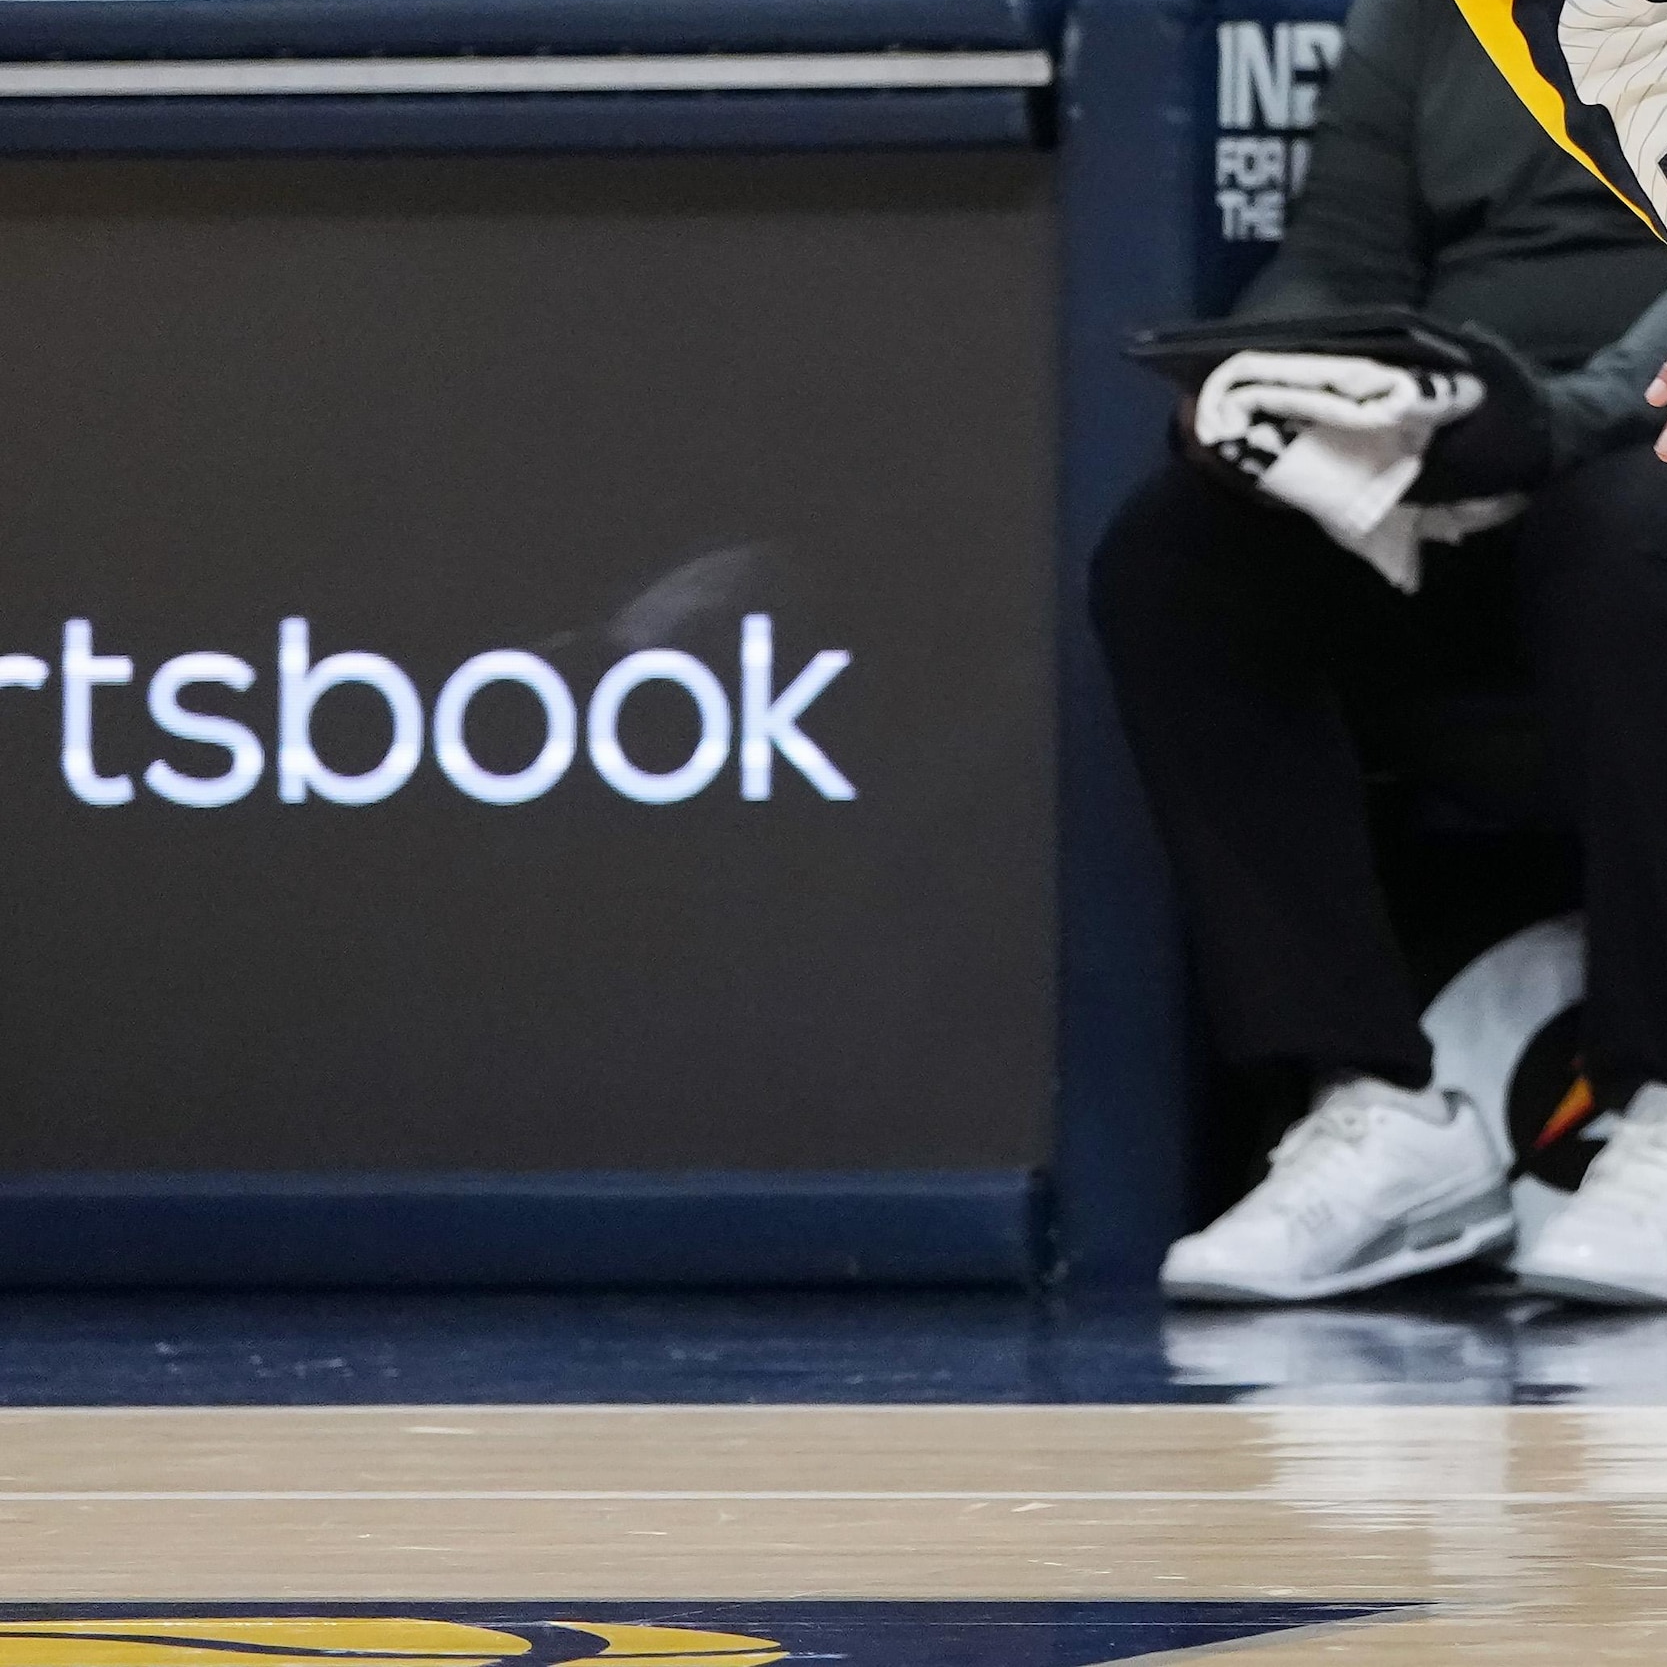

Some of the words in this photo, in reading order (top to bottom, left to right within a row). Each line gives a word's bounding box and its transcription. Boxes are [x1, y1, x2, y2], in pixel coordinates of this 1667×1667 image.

[1215, 136, 1286, 187] FOR
[1215, 190, 1286, 242] THE
[0, 613, 858, 807] tsbook
